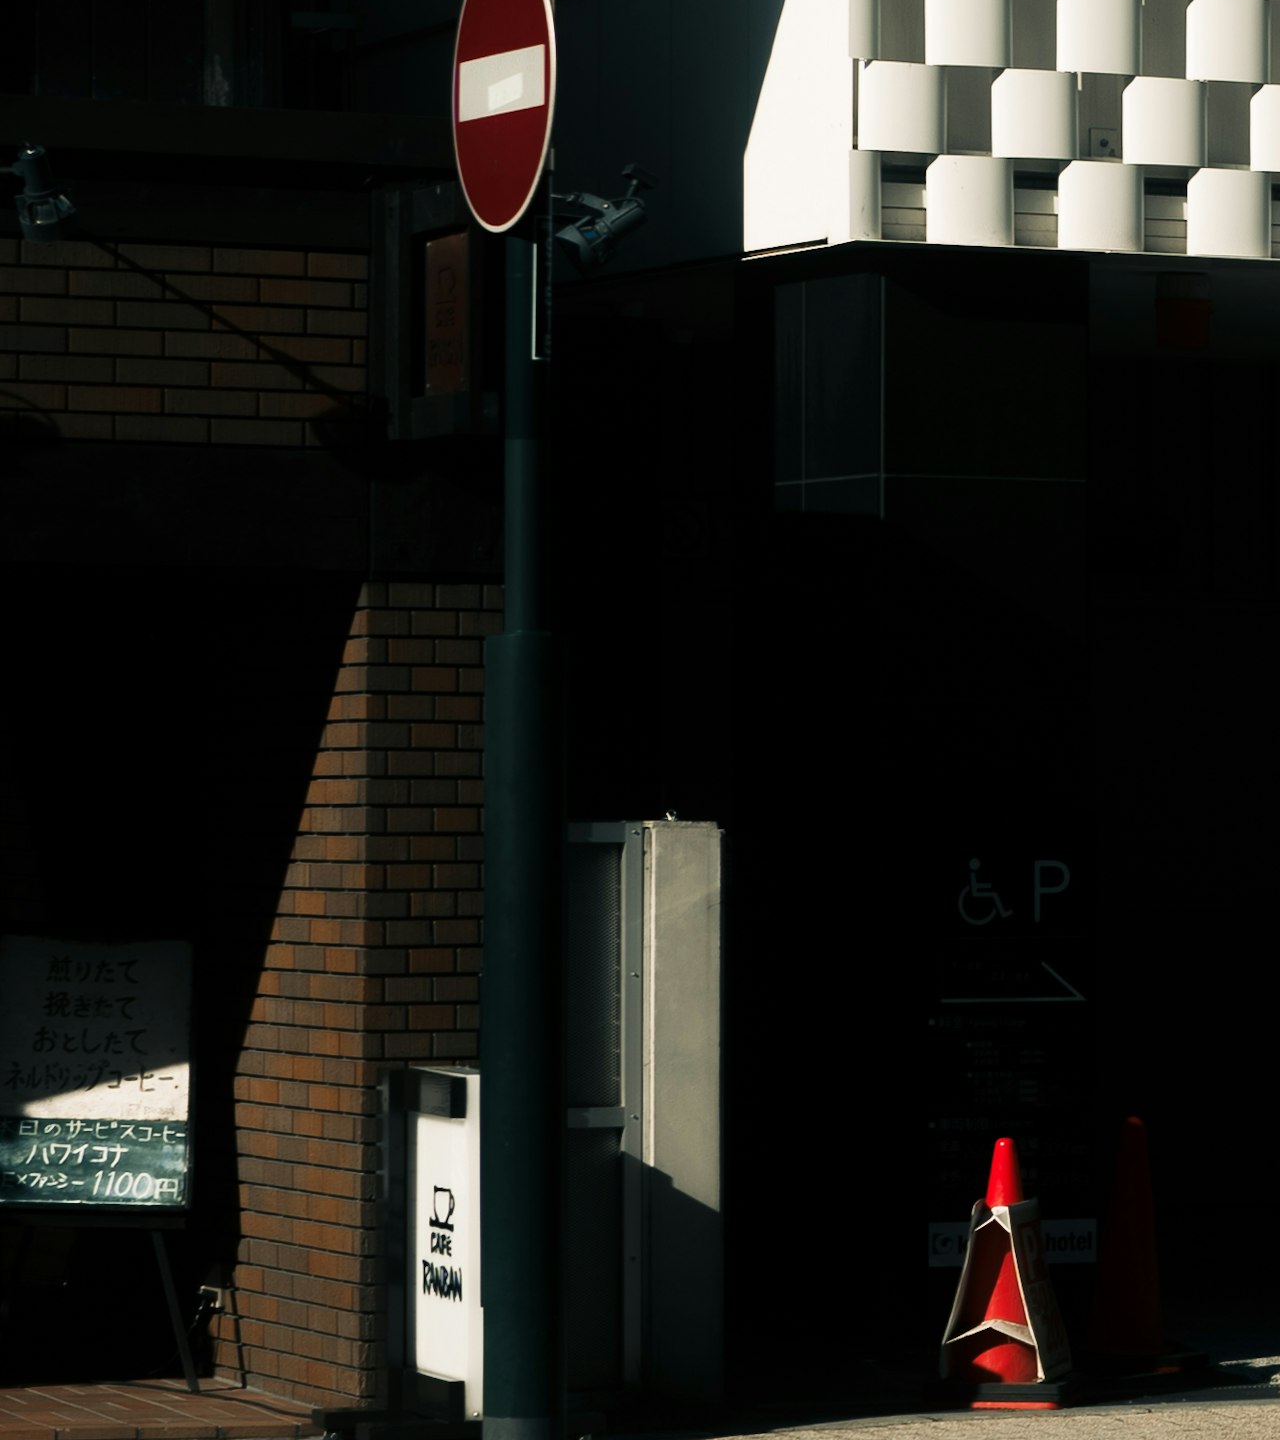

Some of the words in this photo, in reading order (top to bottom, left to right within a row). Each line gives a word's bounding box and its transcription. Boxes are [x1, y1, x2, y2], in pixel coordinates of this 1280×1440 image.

[1034, 859, 1071, 923] P
[92, 1170, 179, 1199] 1100円
[1046, 1228, 1092, 1259] hotel
